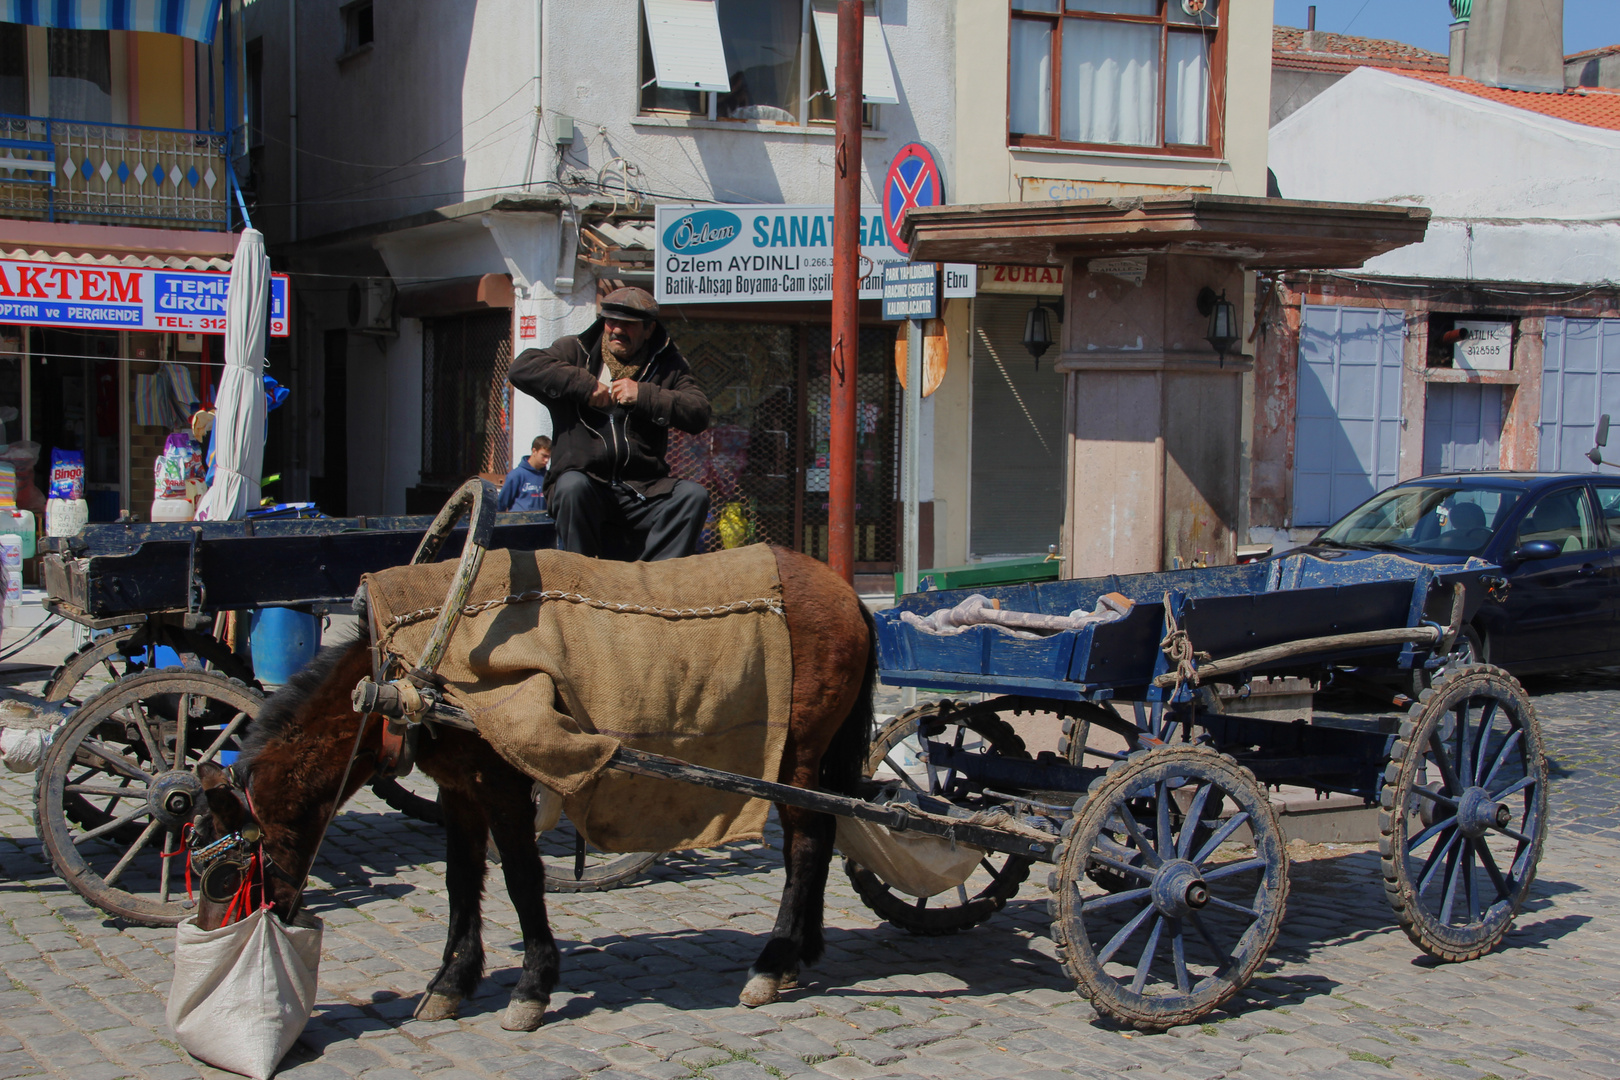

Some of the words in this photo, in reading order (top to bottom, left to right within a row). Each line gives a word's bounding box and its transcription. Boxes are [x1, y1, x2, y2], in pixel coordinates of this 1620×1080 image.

[672, 217, 735, 250] Özlem
[666, 254, 722, 273] Özlem
[727, 254, 800, 272] AYDINLI
[885, 267, 899, 282] PARK
[665, 274, 732, 297] Batik-Ahşap
[735, 273, 805, 296] Boyama-Cam
[884, 284, 908, 299] ARACINIZ
[45, 308, 60, 318] ve
[67, 306, 140, 322] PERAKENDE
[887, 299, 932, 316] KALDIRILACAKTIR
[155, 316, 193, 329] TEL:
[1467, 329, 1499, 341] ATILIK
[54, 468, 82, 481] Bingo
